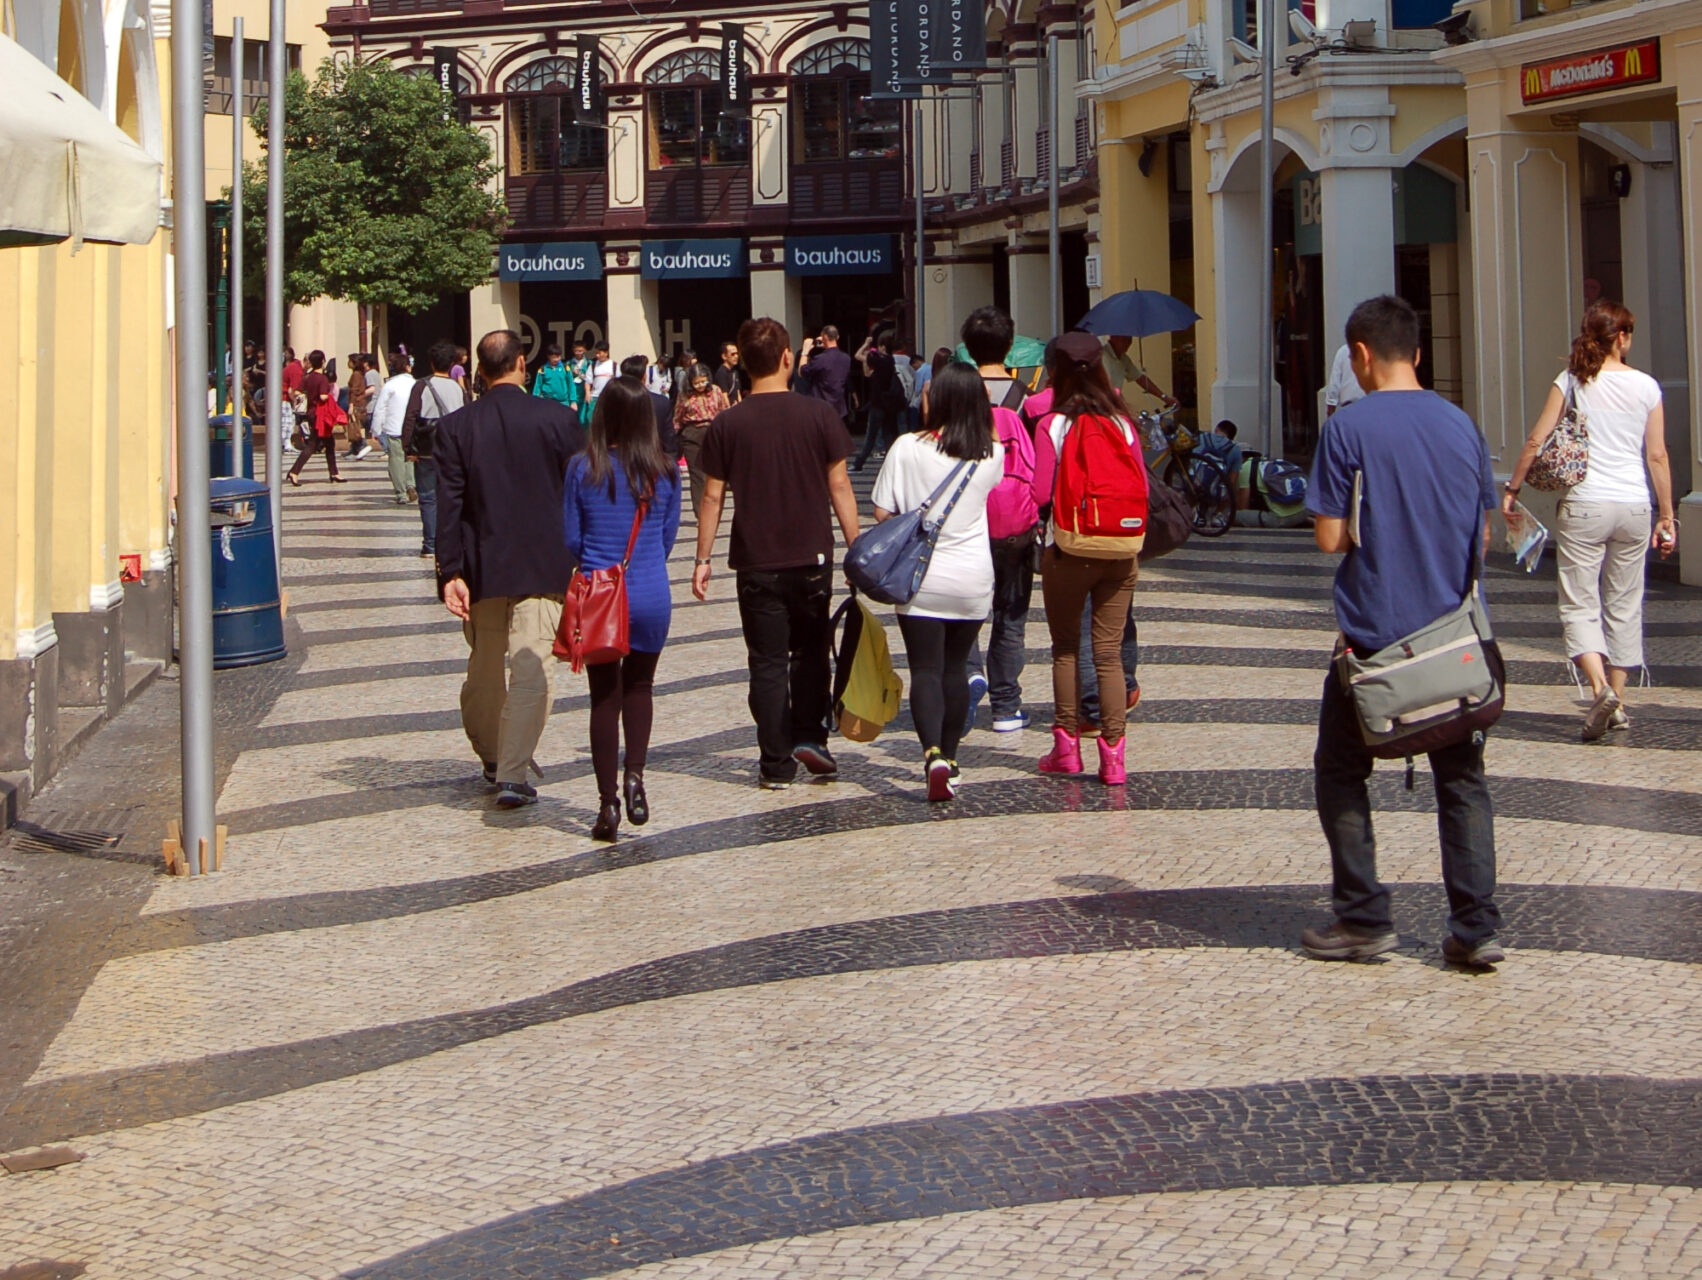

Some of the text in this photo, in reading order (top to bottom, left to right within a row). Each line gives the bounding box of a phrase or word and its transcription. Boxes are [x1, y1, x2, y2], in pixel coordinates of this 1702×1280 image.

[581, 50, 592, 110] bauhaus
[728, 39, 738, 100] bauhaus
[1550, 54, 1614, 88] McDonald's
[507, 254, 586, 273] bauhaus
[650, 250, 732, 270] bauhaus
[795, 246, 882, 266] bauhaus
